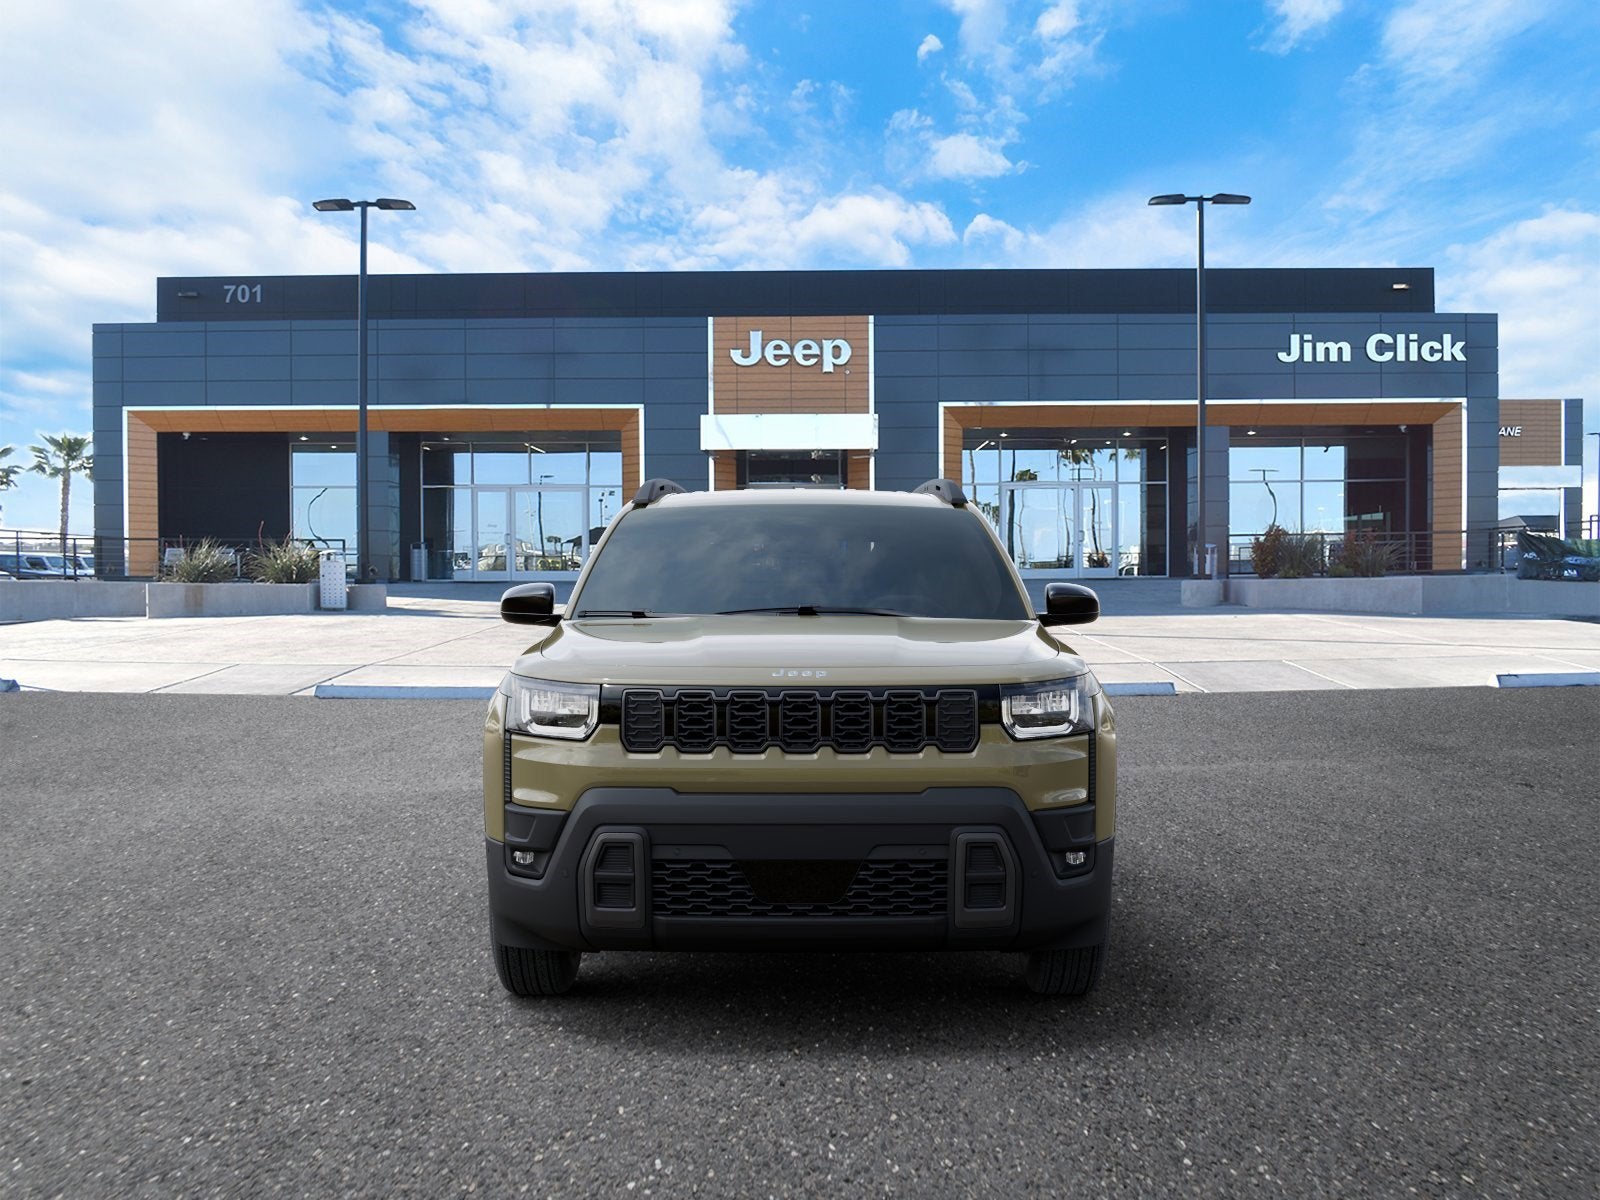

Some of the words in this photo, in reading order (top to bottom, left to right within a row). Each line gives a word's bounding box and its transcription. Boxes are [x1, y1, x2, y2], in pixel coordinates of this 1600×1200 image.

[223, 284, 262, 303] 701
[730, 329, 852, 373] Jeep
[1277, 333, 1351, 363] Jim
[1366, 333, 1467, 362] Click
[771, 668, 828, 679] Jeep
